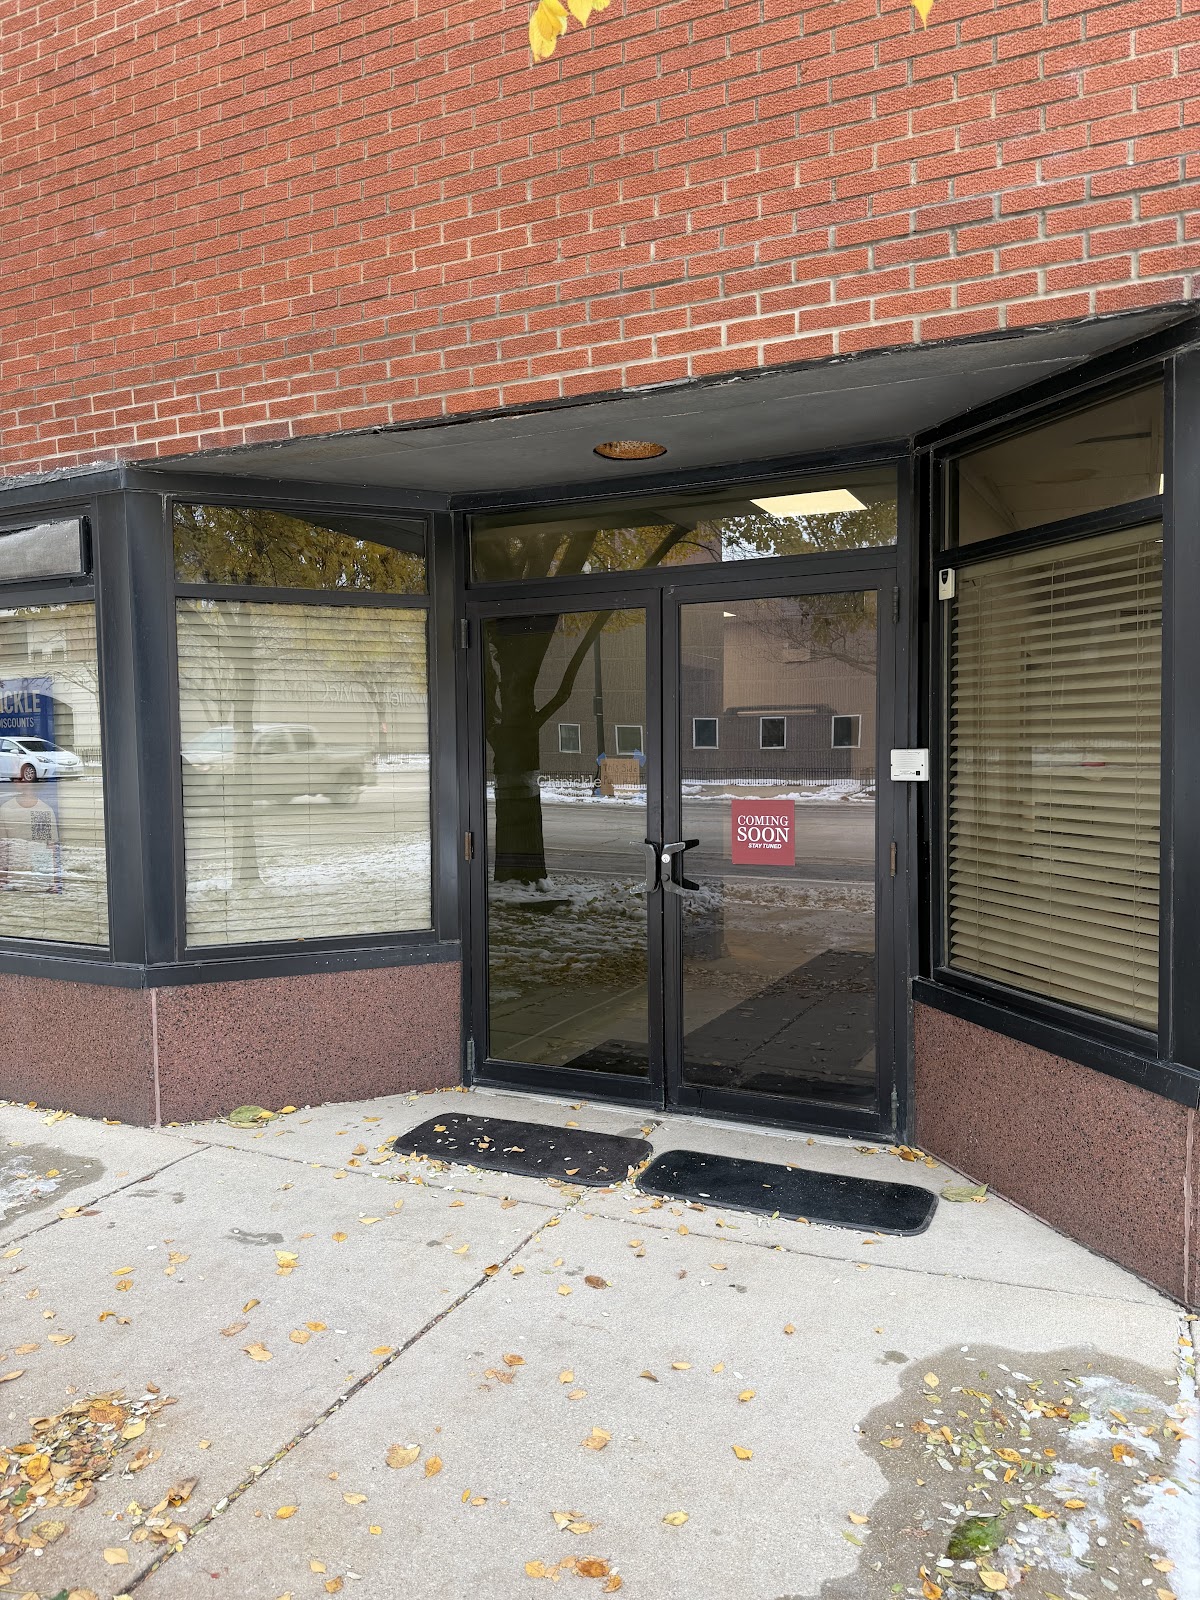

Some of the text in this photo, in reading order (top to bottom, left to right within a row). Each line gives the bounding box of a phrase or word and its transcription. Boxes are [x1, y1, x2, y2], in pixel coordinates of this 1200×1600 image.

[603, 763, 638, 773] This Side
[536, 774, 602, 790] Chipickle
[737, 815, 789, 826] COMING
[737, 827, 790, 843] SOON
